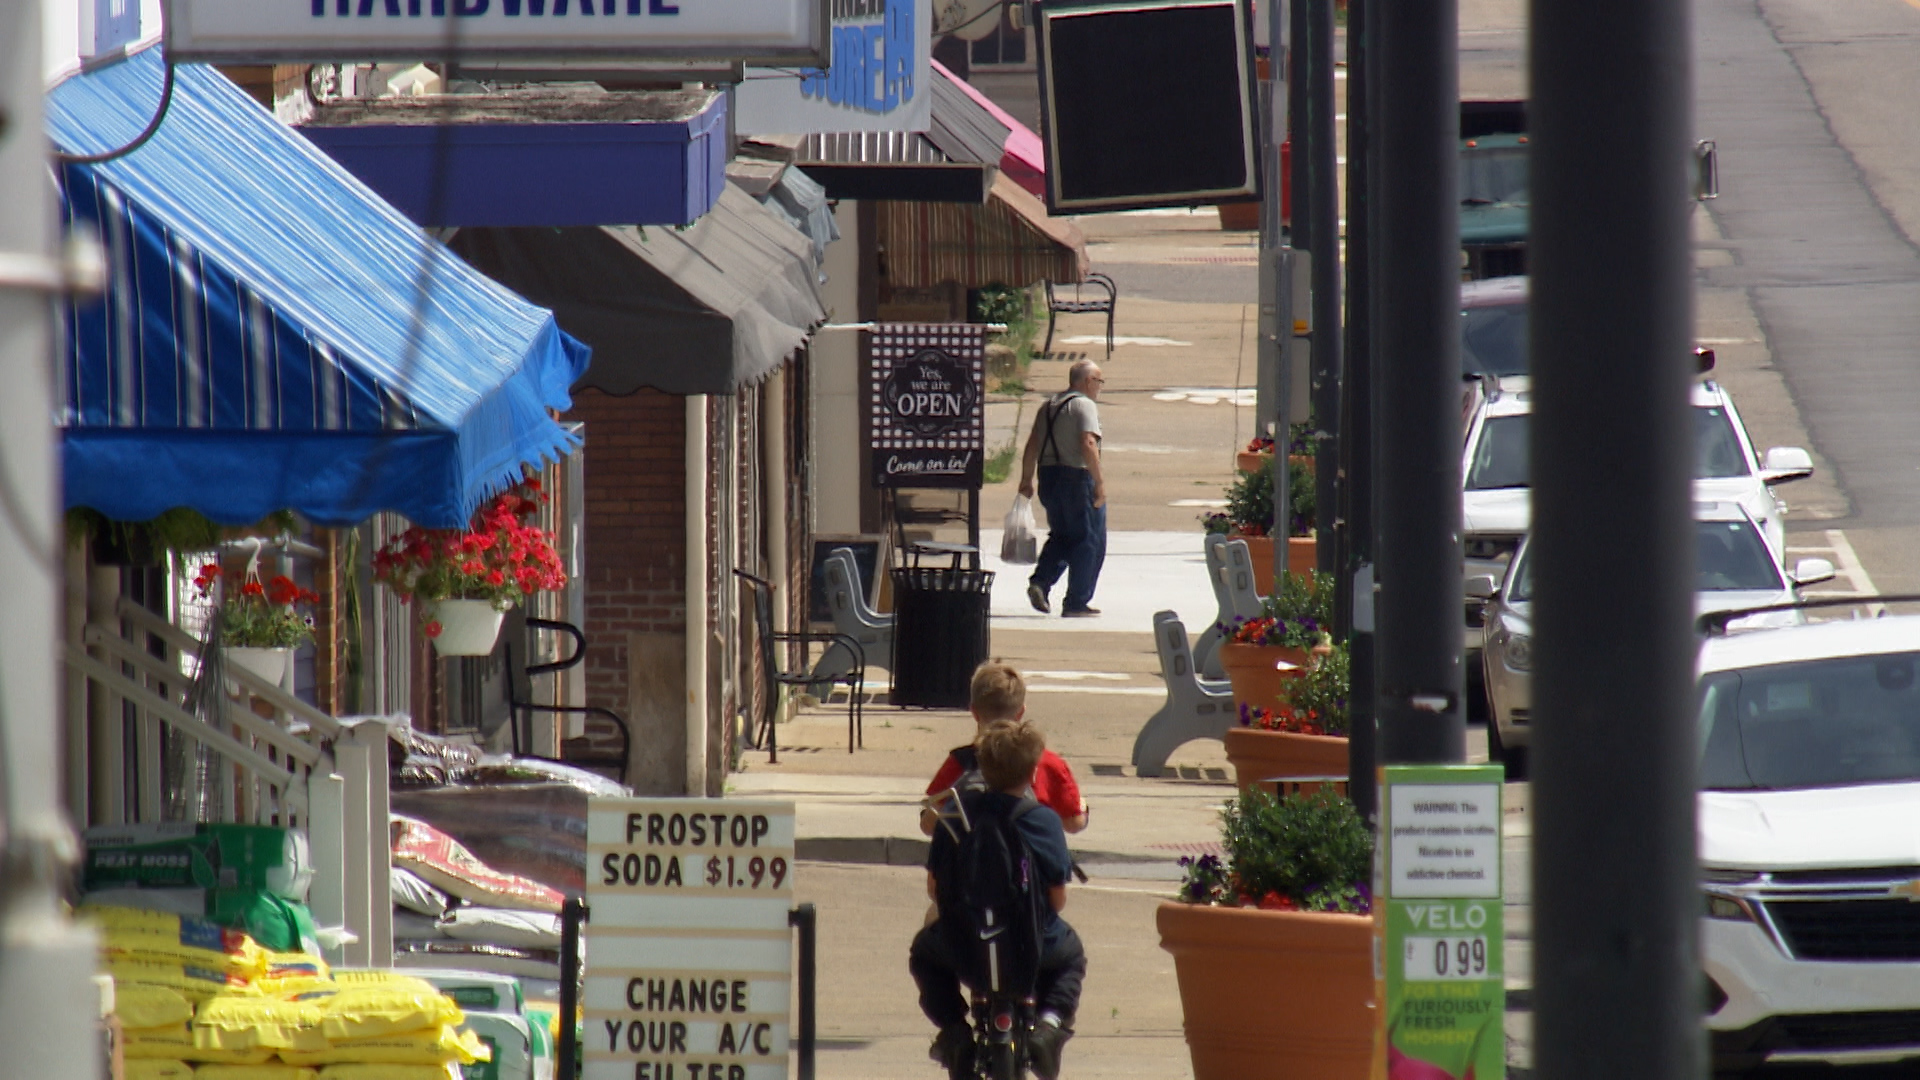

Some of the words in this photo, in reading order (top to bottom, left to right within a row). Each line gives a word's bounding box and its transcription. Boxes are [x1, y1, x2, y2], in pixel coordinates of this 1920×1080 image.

[920, 366, 942, 380] Yes,
[911, 382, 927, 391] we
[931, 382, 951, 391] are
[897, 393, 962, 416] OPEN
[886, 455, 925, 474] Come
[926, 457, 945, 470] on
[948, 451, 972, 470] in!
[626, 812, 769, 848] FROSTOP
[95, 855, 136, 868] PEAT
[141, 854, 190, 868] MOSS
[603, 853, 682, 887] SODA
[706, 855, 787, 889] $1.99
[1405, 905, 1487, 929] VELO
[626, 977, 747, 1014] CHANGE
[1403, 983, 1436, 998] FOR
[1440, 983, 1482, 998] THAT
[1404, 1000, 1492, 1014] FURIOUSLY
[1405, 1015, 1456, 1029] FRESH
[605, 1019, 687, 1054] YOUR
[718, 1021, 771, 1055] A/C
[1404, 1031, 1478, 1045] MOMENT
